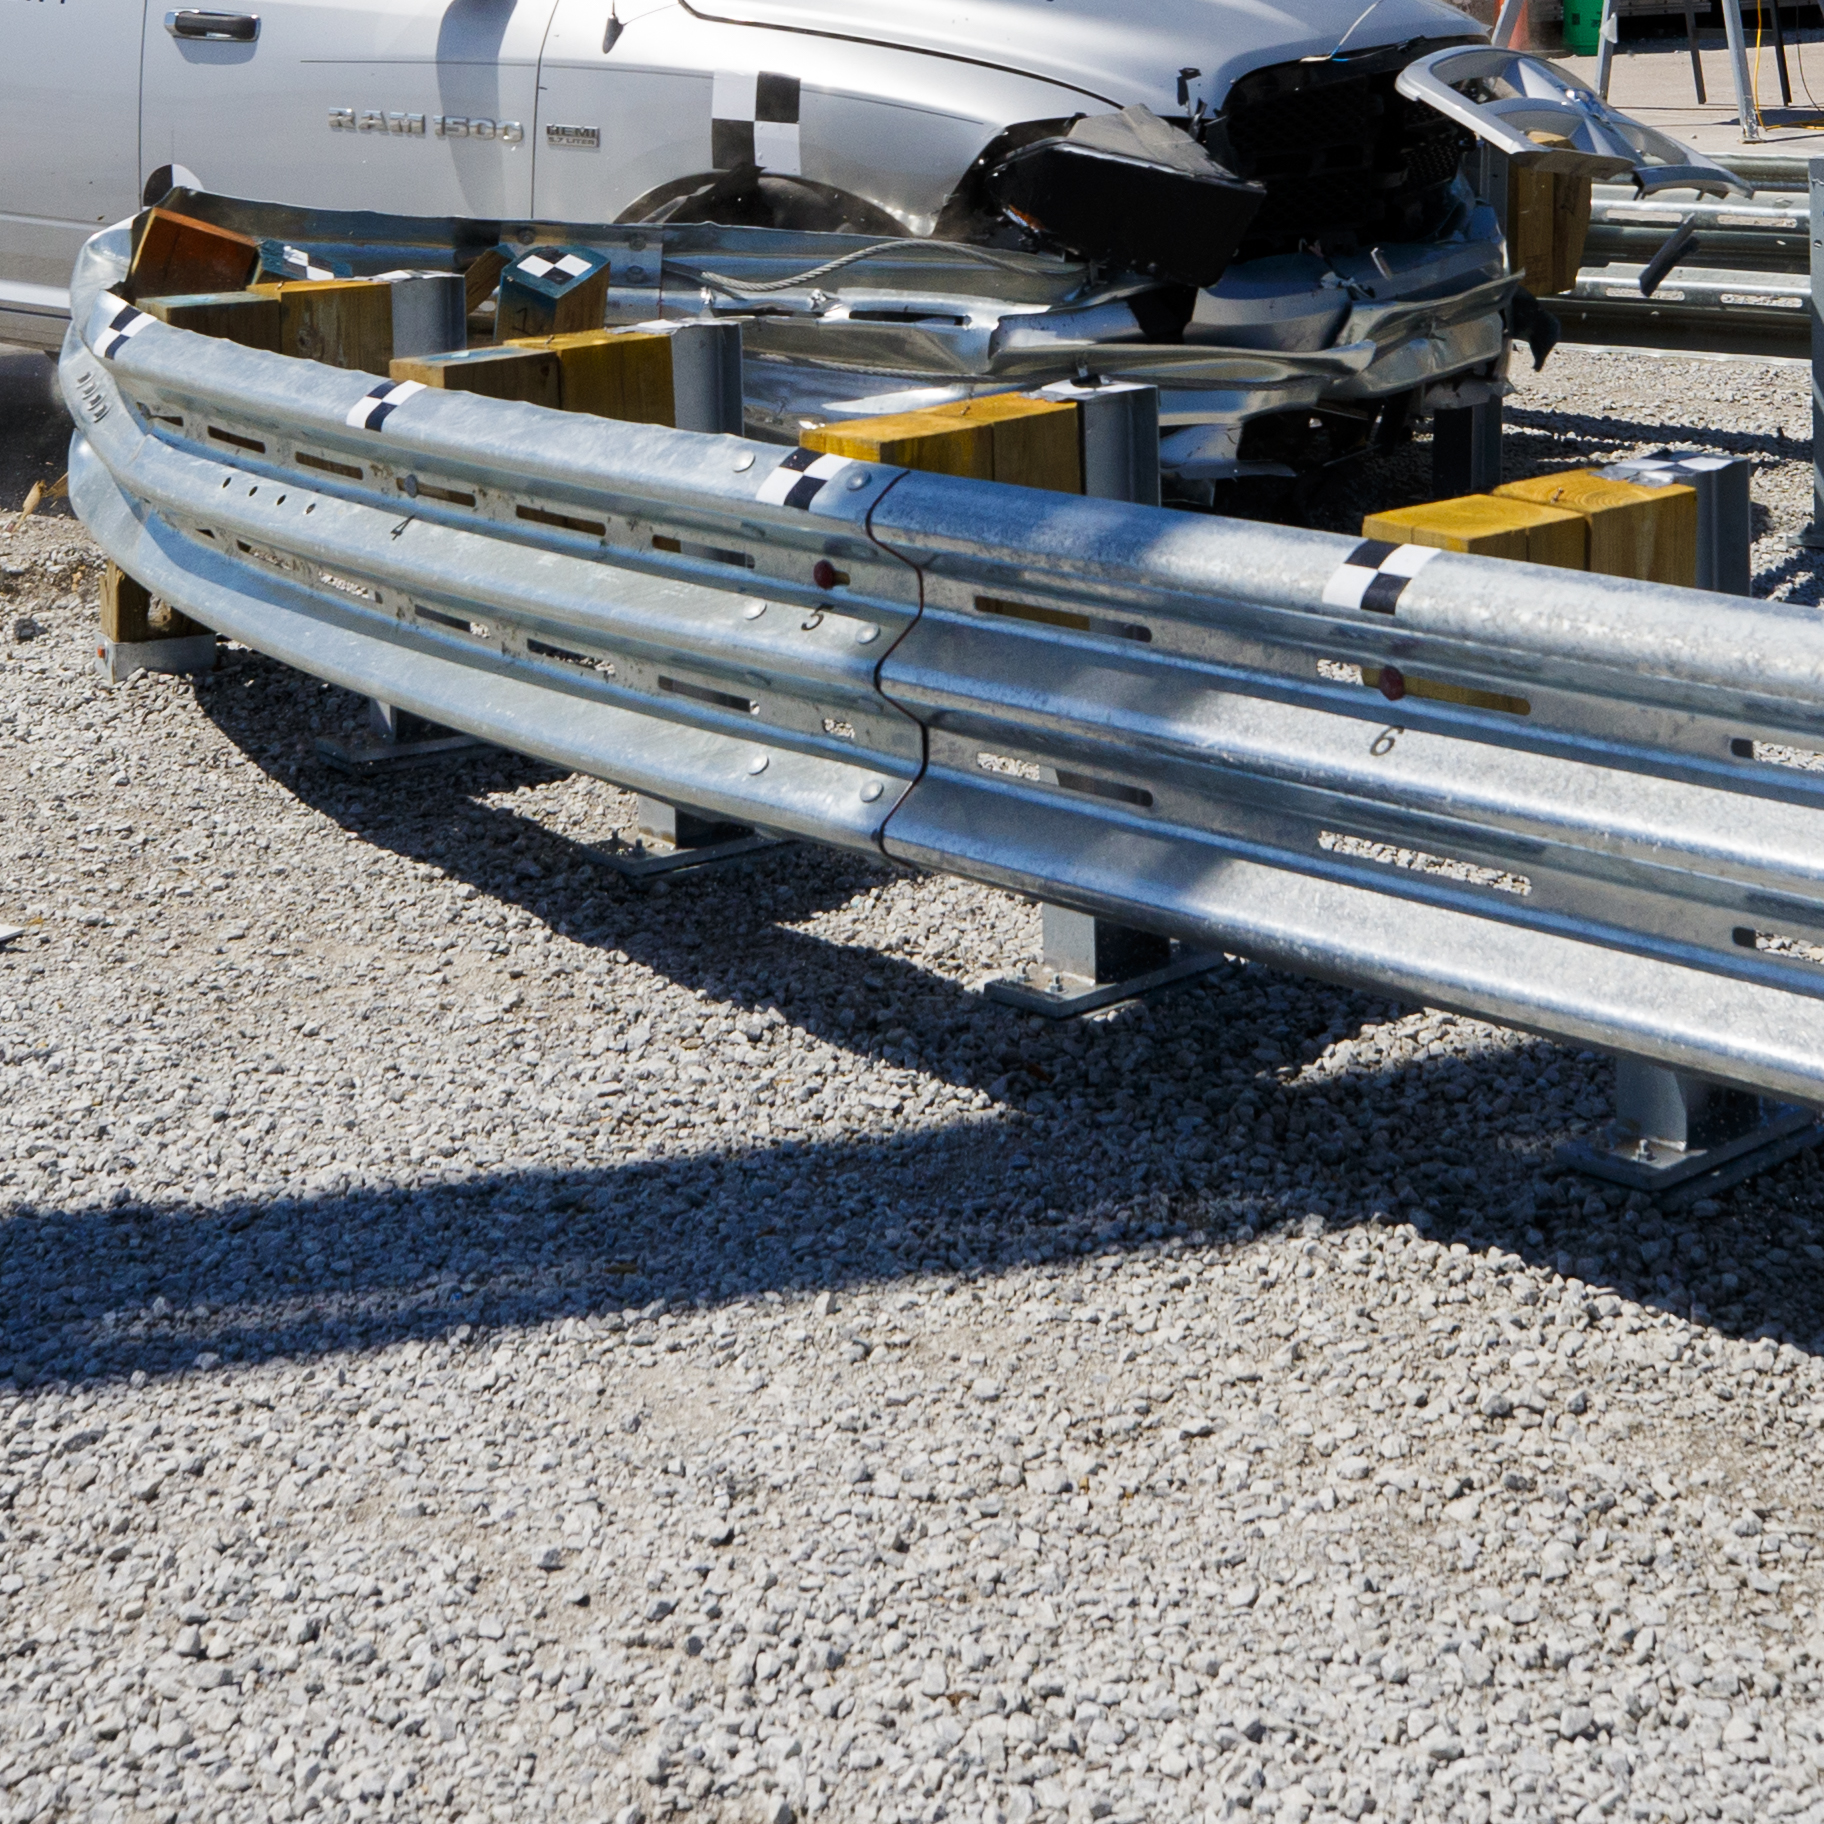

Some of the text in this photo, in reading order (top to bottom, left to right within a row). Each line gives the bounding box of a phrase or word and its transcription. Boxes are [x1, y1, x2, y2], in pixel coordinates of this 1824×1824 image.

[328, 107, 524, 143] RAM 1500
[547, 125, 596, 138] HEMI
[390, 514, 415, 541] 4
[801, 602, 834, 631] 5
[1370, 725, 1404, 756] 6
